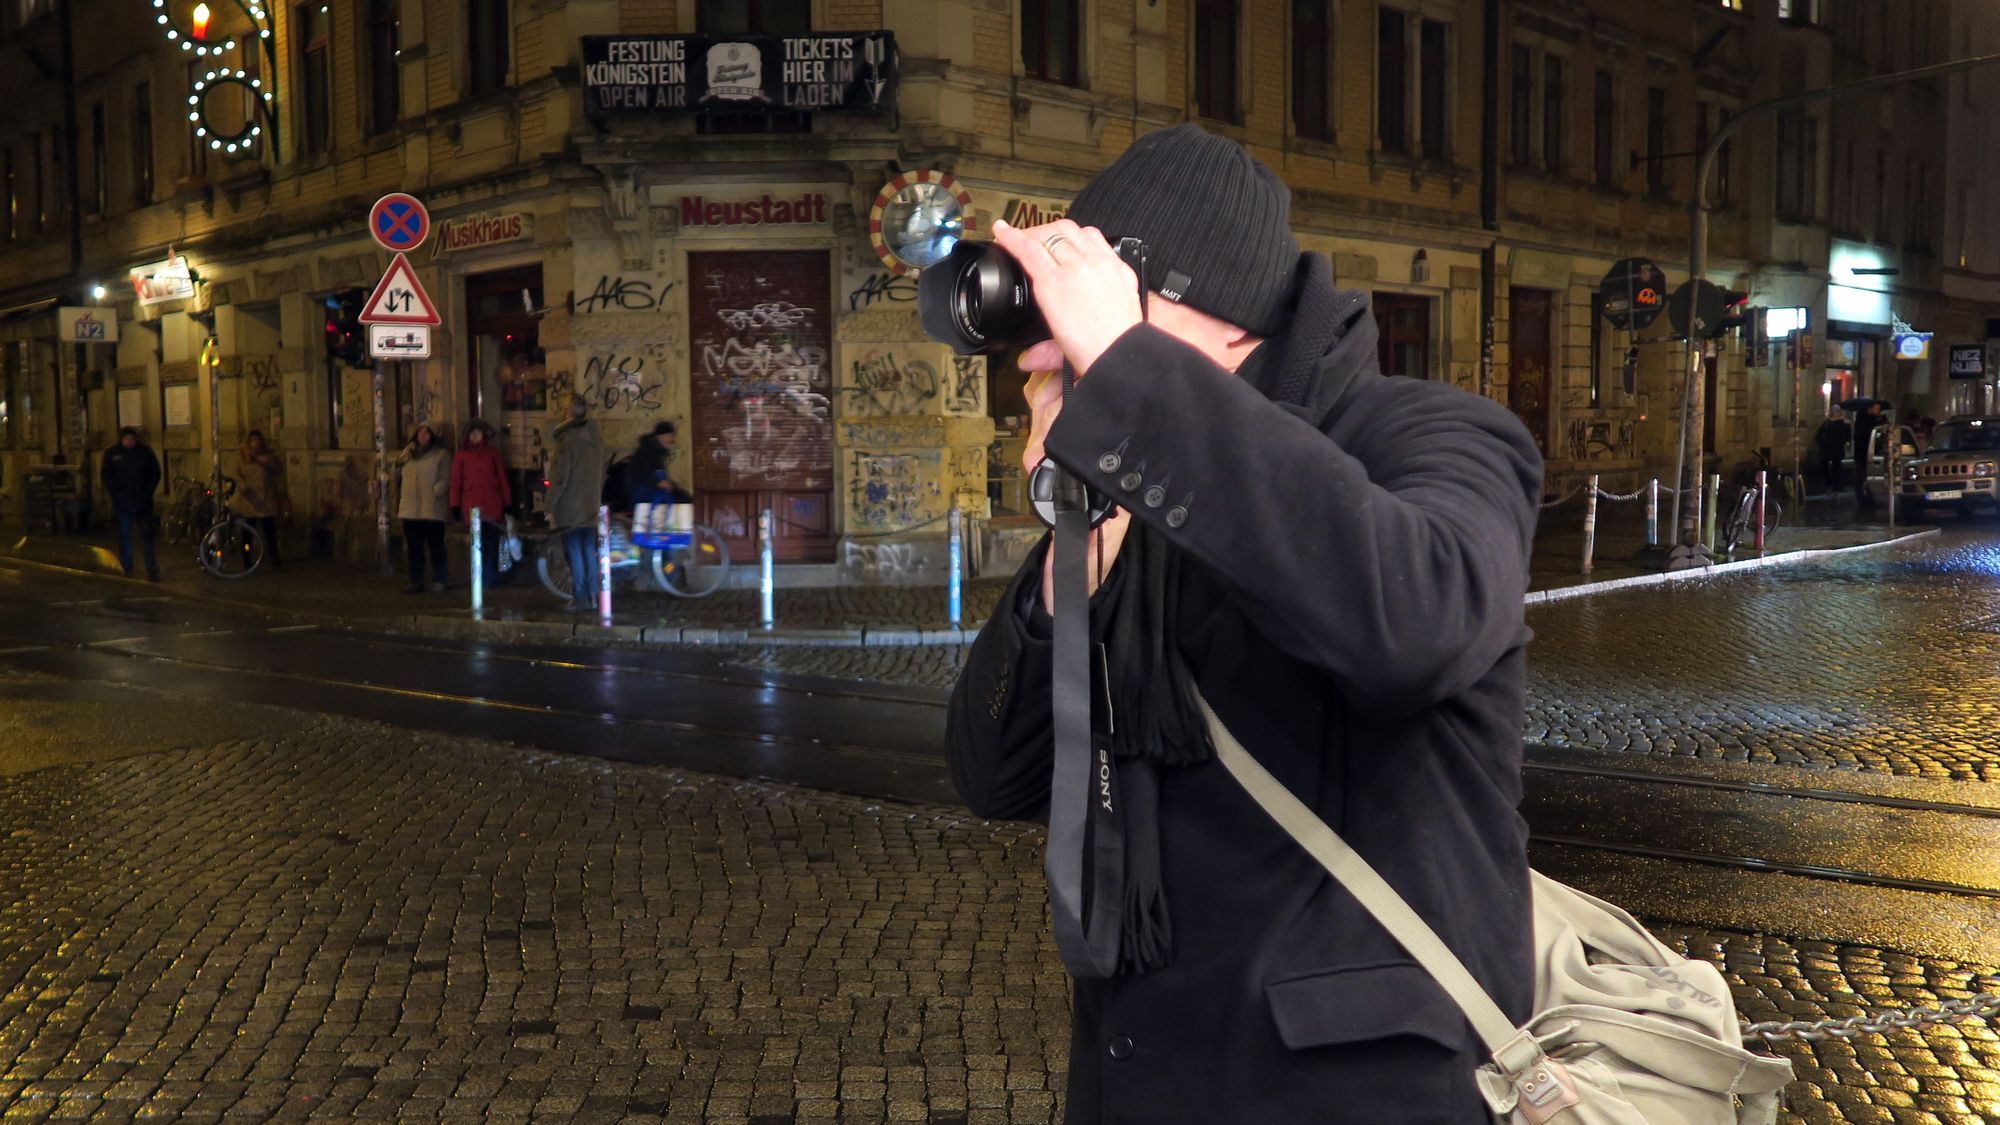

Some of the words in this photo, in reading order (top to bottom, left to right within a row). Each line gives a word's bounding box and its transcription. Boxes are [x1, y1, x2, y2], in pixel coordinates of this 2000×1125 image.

[608, 40, 686, 62] FESTUNG
[782, 38, 853, 60] TICKETS
[586, 61, 687, 86] KÖNIGSTEIN
[783, 61, 825, 82] HIER
[833, 60, 853, 82] IM
[601, 86, 648, 108] OPEN
[655, 85, 687, 107] AIR
[783, 84, 844, 106] LADEN
[681, 193, 827, 226] Neustadt
[432, 214, 522, 257] Musikhaus
[1100, 750, 1114, 813] SONY
